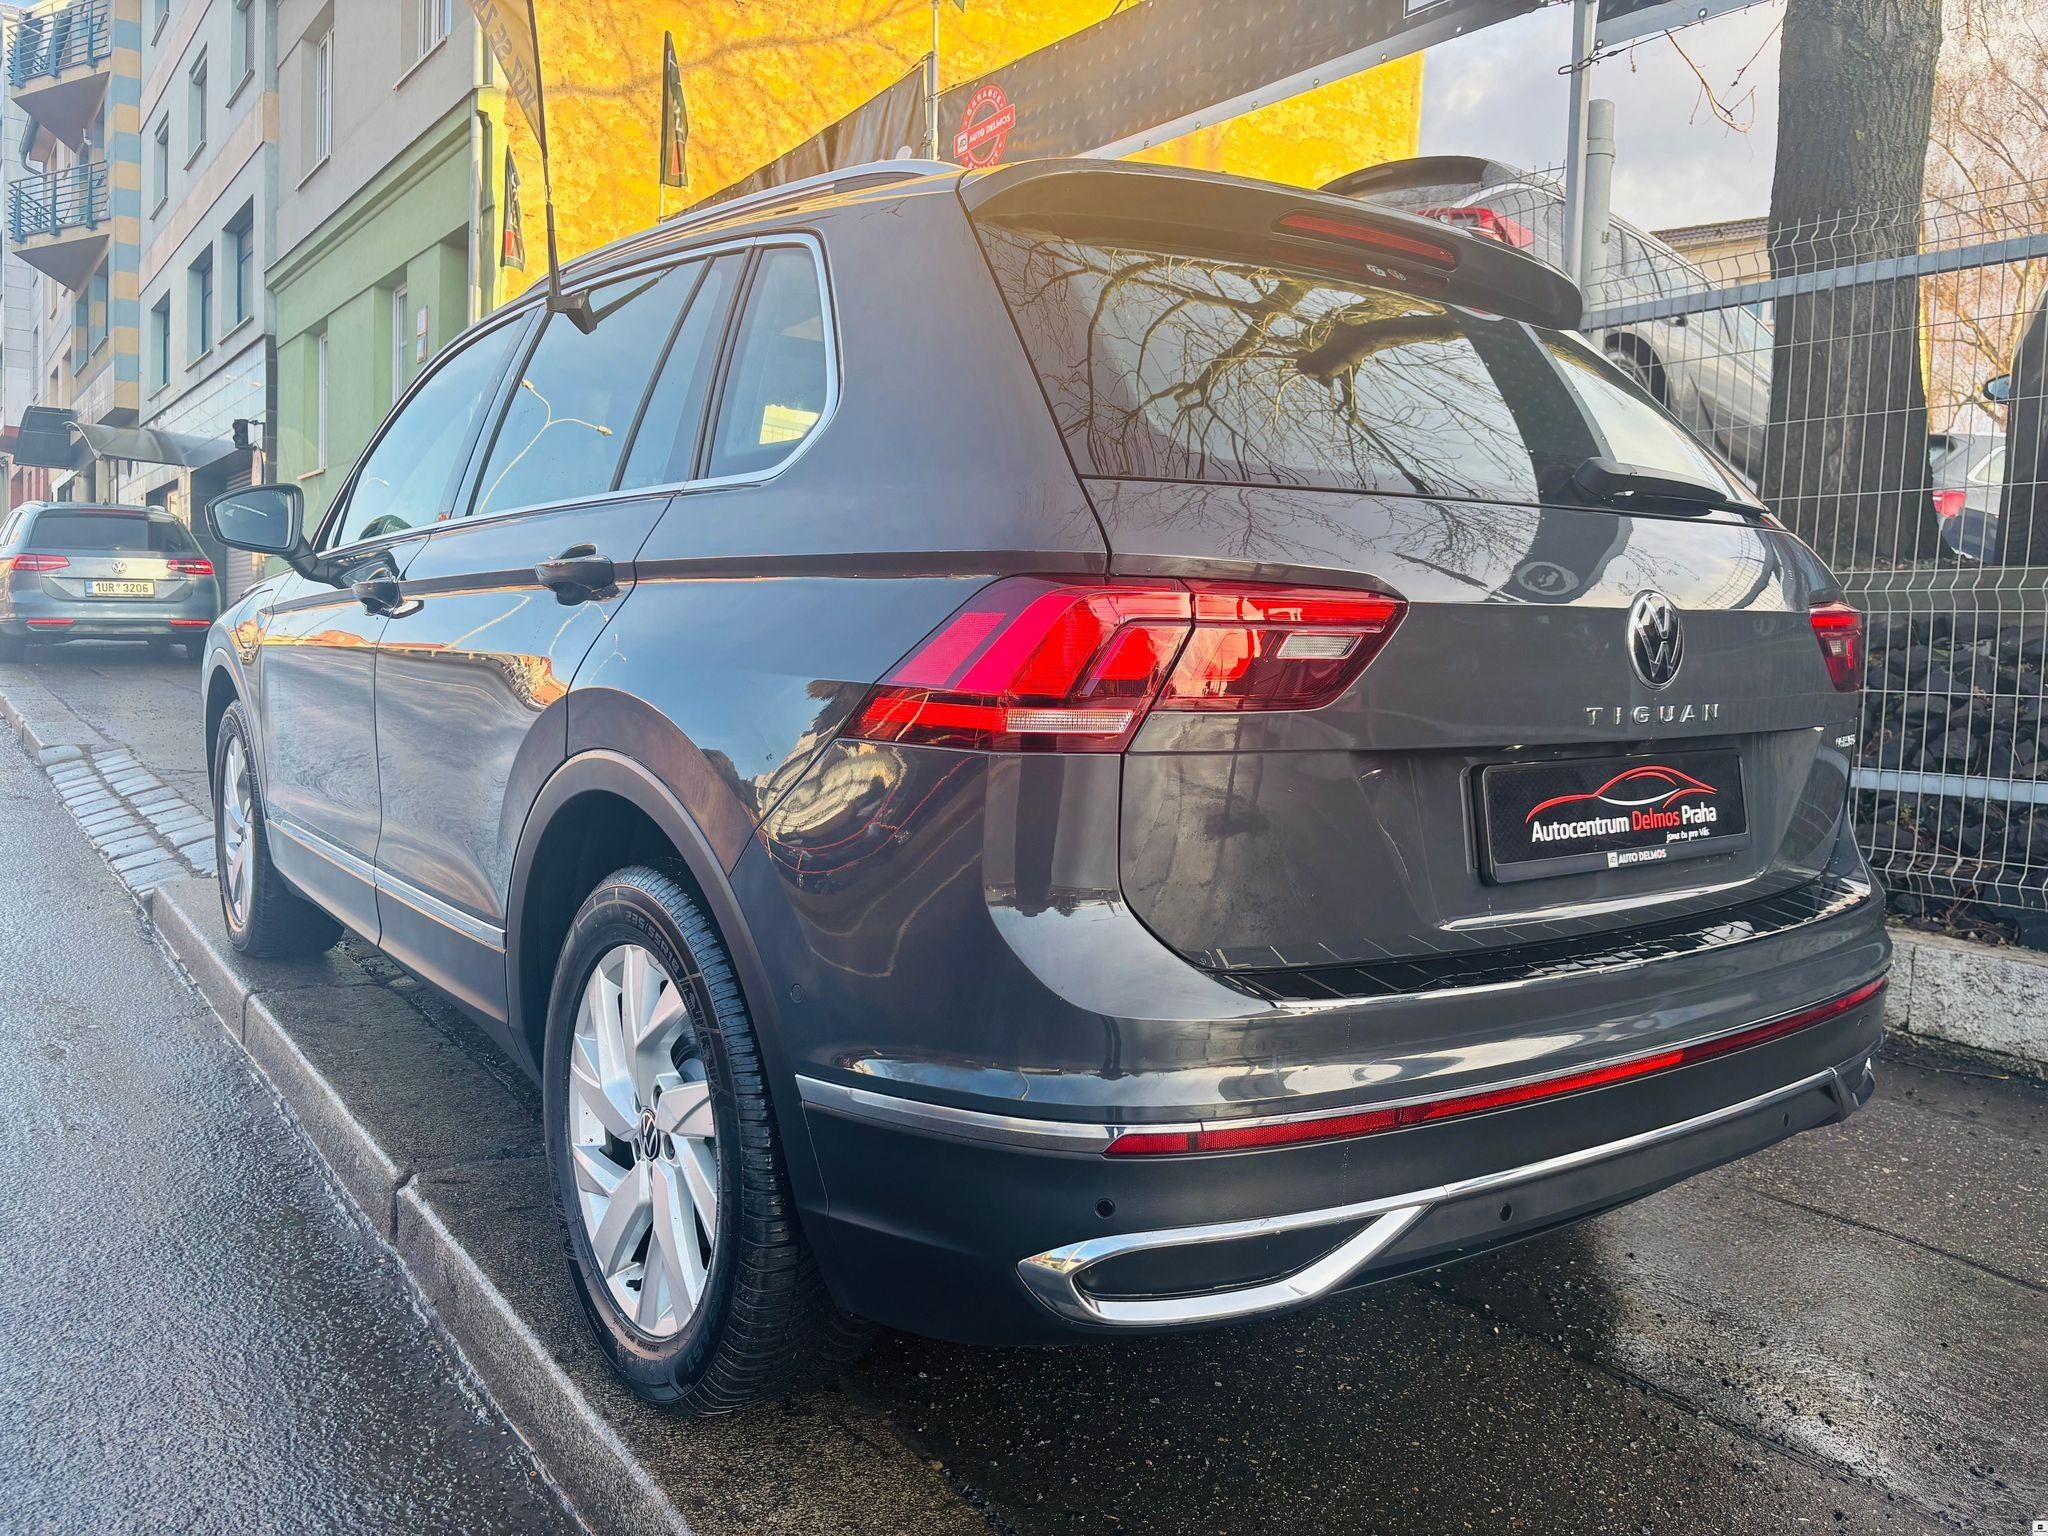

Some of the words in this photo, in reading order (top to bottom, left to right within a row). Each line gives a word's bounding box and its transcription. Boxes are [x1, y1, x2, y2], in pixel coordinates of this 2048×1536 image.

[968, 128, 986, 144] AUTO
[985, 113, 1012, 135] DELMOS
[96, 583, 115, 593] 1UR
[123, 583, 149, 593] 3206
[1584, 703, 1719, 725] TIGUAN
[1531, 815, 1630, 843] Autocentrum
[1631, 808, 1681, 831] Delmos
[1681, 801, 1717, 825] Praha
[1618, 852, 1638, 864] AUTO
[1638, 849, 1667, 861] DELMOS
